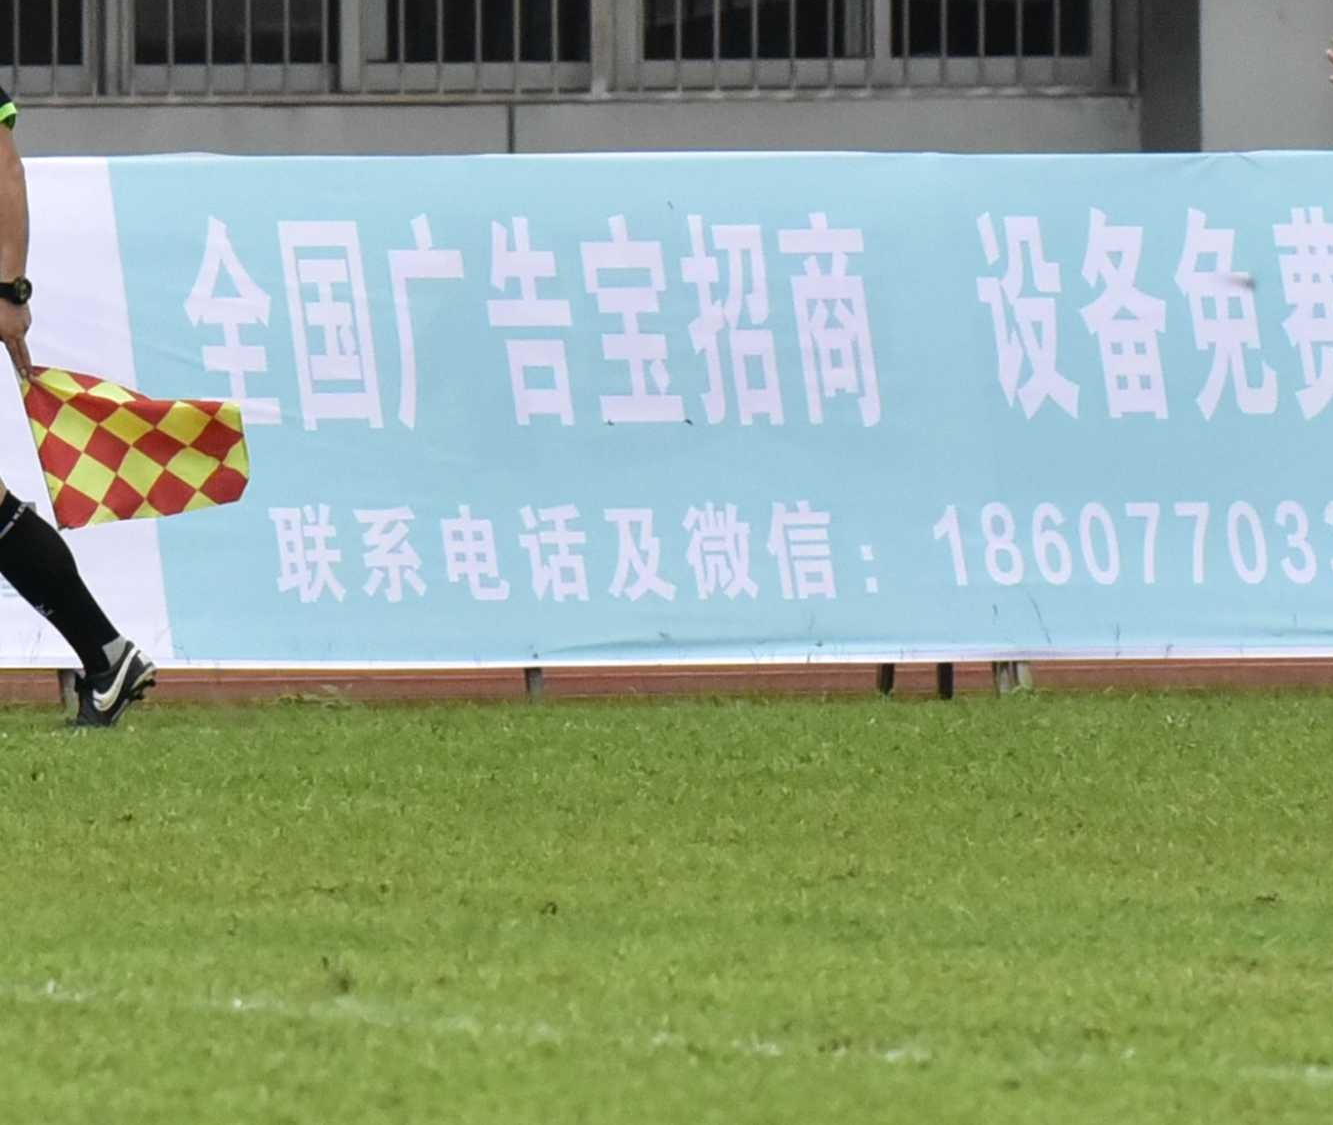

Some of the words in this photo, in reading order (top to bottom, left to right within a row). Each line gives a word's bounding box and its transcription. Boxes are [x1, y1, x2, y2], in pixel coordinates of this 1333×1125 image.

[183, 212, 882, 430] 全国广告宝招商
